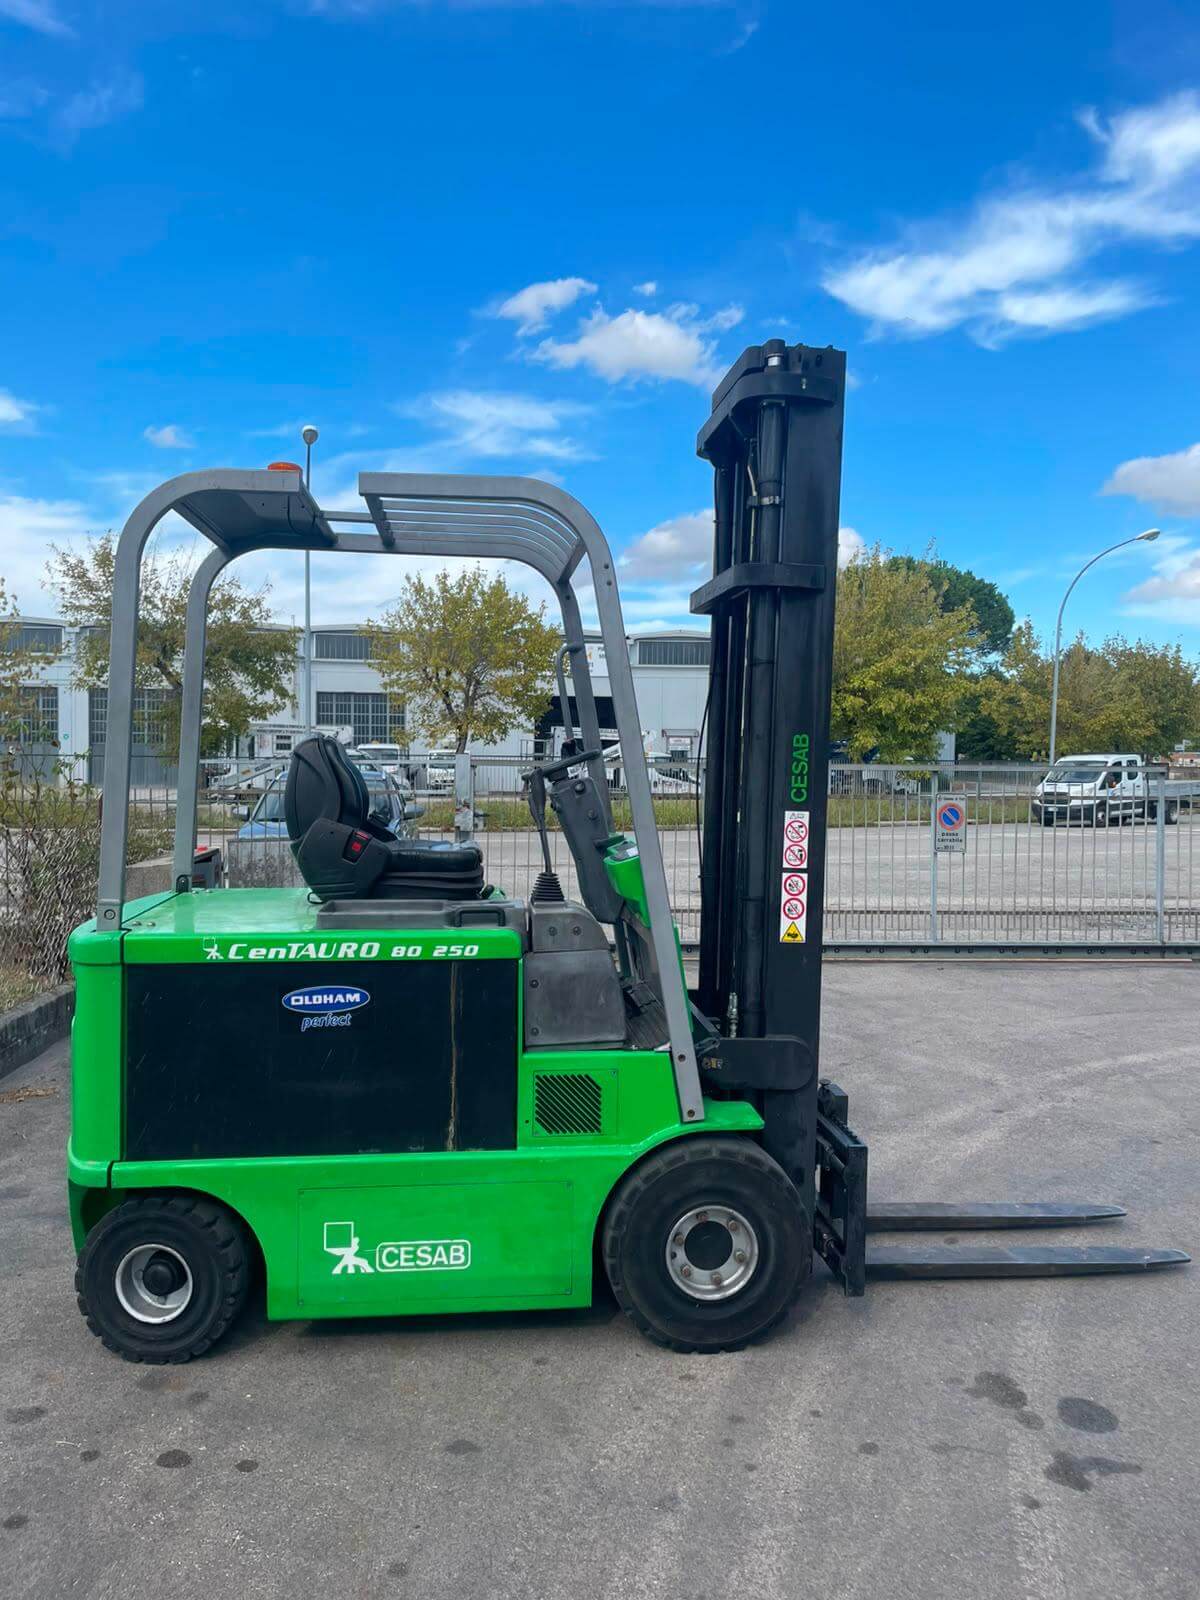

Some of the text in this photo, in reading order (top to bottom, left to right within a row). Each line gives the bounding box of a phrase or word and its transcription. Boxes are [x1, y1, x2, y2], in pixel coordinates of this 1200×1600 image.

[790, 734, 810, 803] CESAB
[390, 945, 422, 958] 80
[432, 944, 479, 957] 250
[290, 992, 361, 1006] OLDHAM
[301, 1012, 352, 1032] perfect
[381, 1244, 466, 1268] CESAB
